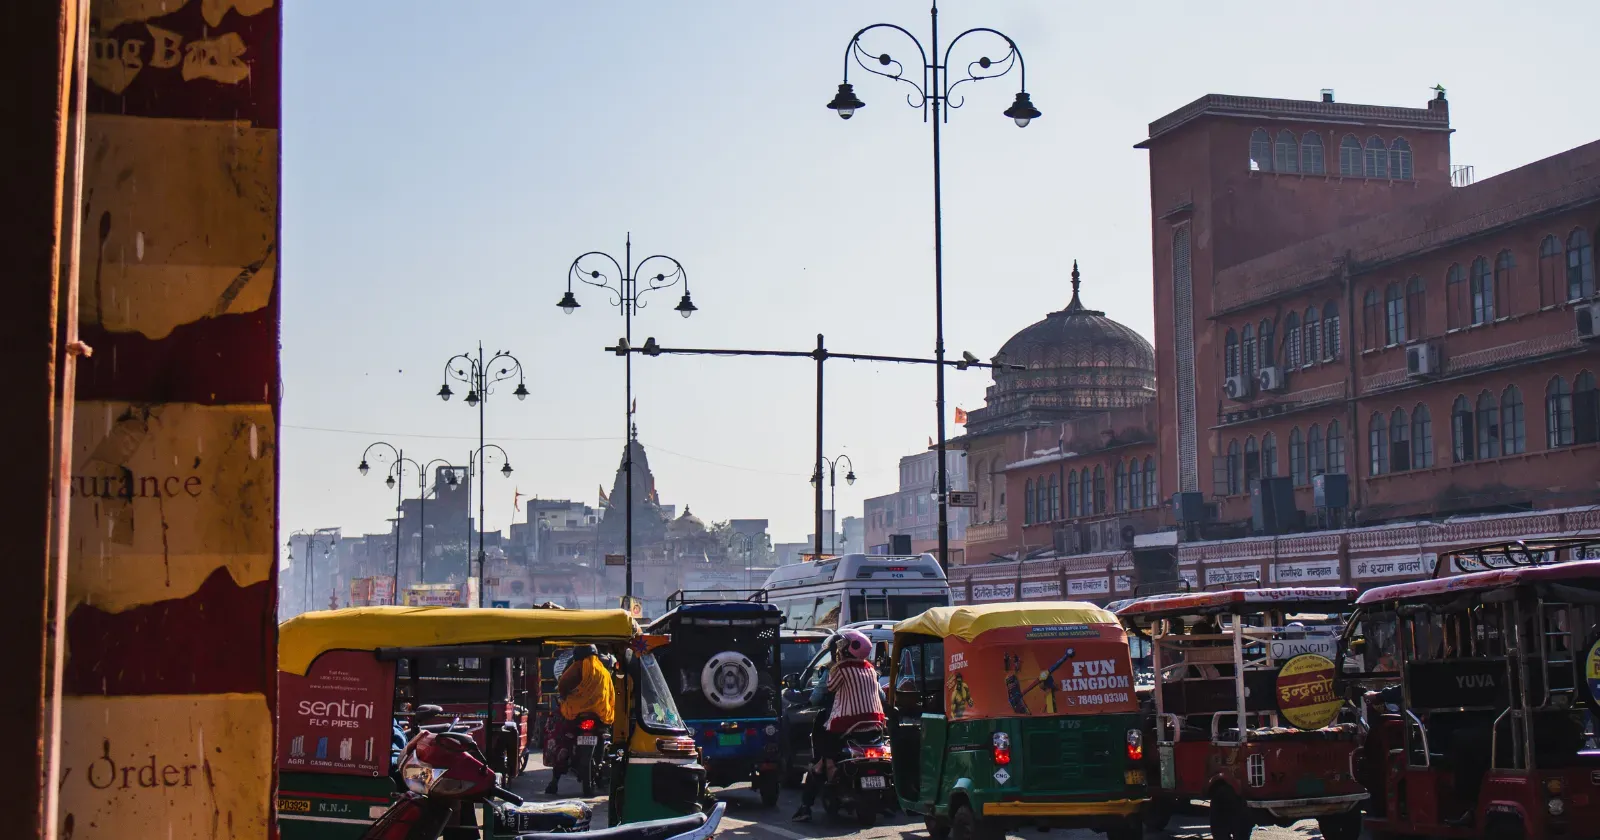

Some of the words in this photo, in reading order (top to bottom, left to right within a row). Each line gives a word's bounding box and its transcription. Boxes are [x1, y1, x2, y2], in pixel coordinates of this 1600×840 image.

[1280, 565, 1303, 578] भगीरथ
[1357, 562, 1367, 575] श्री
[1370, 563, 1394, 575] श्याम
[1288, 643, 1330, 655] JANGID
[951, 652, 964, 663] FUN
[1071, 659, 1116, 677] FUN
[1061, 675, 1130, 692] KINGDOM
[1455, 674, 1496, 689] YUVA
[1077, 694, 1103, 705] 78499
[1103, 692, 1129, 704] 03304
[297, 699, 374, 719] sentini
[309, 718, 329, 727] FLO
[331, 719, 360, 728] PIPES
[1059, 720, 1081, 729] TVS
[87, 754, 196, 789] Order
[318, 802, 352, 813] N.N.J.
